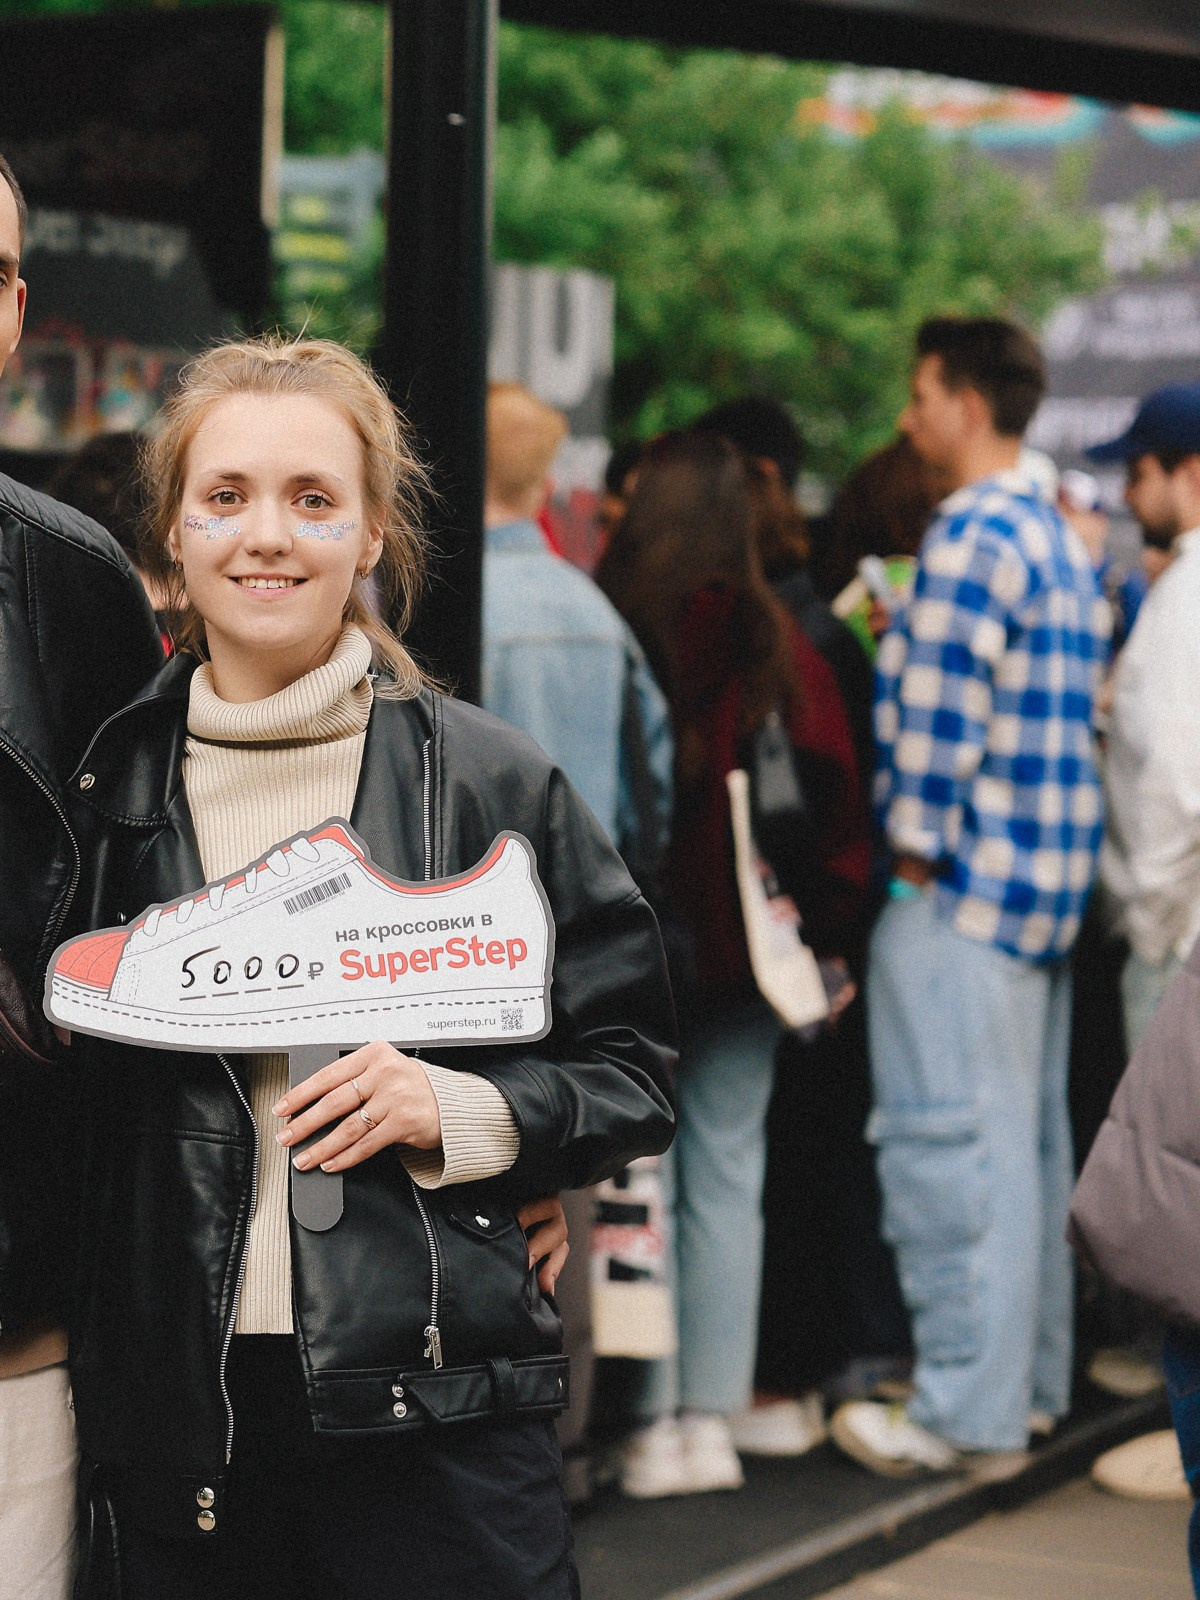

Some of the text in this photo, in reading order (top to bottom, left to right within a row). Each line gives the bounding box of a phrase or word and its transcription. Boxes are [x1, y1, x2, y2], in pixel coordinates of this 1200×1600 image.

[335, 914, 493, 943] на кроссовки в
[339, 935, 528, 985] SuperStep
[426, 1017, 497, 1031] superstep.ru
